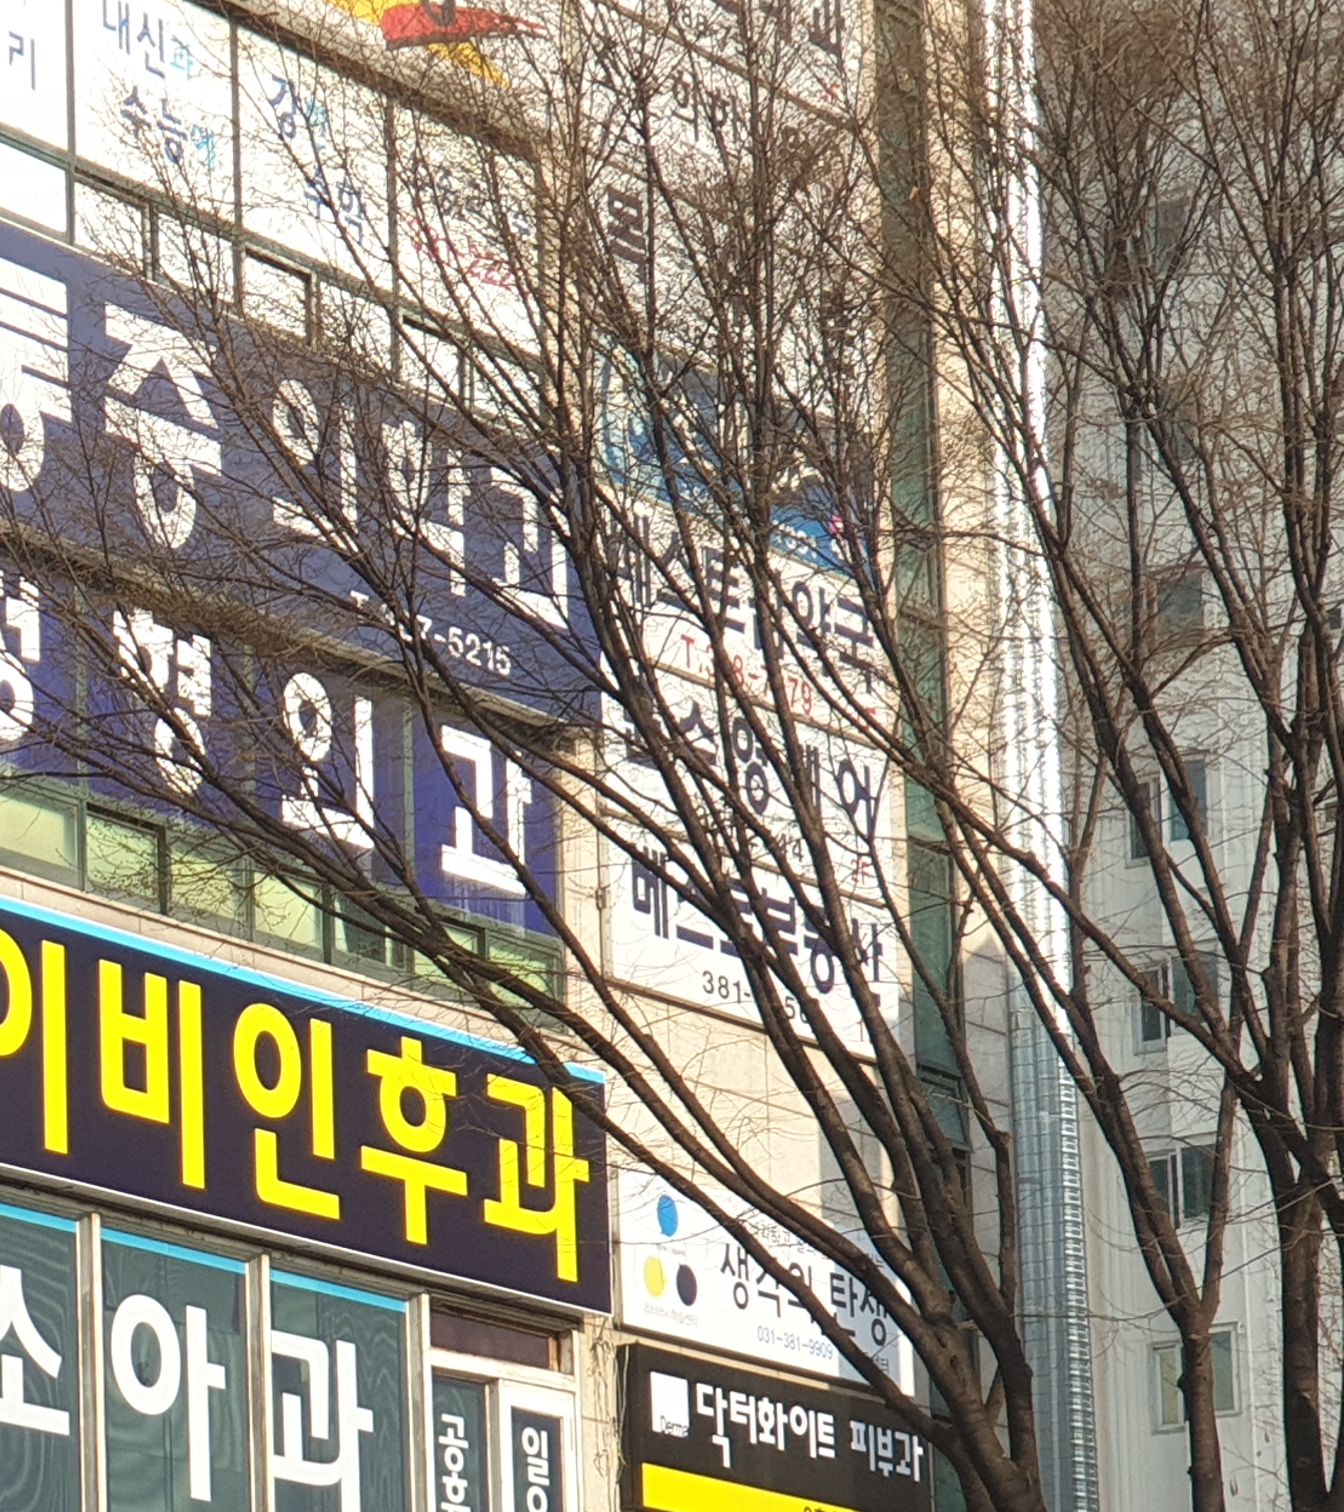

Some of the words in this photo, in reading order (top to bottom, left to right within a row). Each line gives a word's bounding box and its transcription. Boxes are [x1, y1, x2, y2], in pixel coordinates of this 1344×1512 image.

[757, 1325, 834, 1361] 031-381-9909
[695, 1382, 836, 1468] 닥터화이트
[849, 1418, 925, 1483] 피부과
